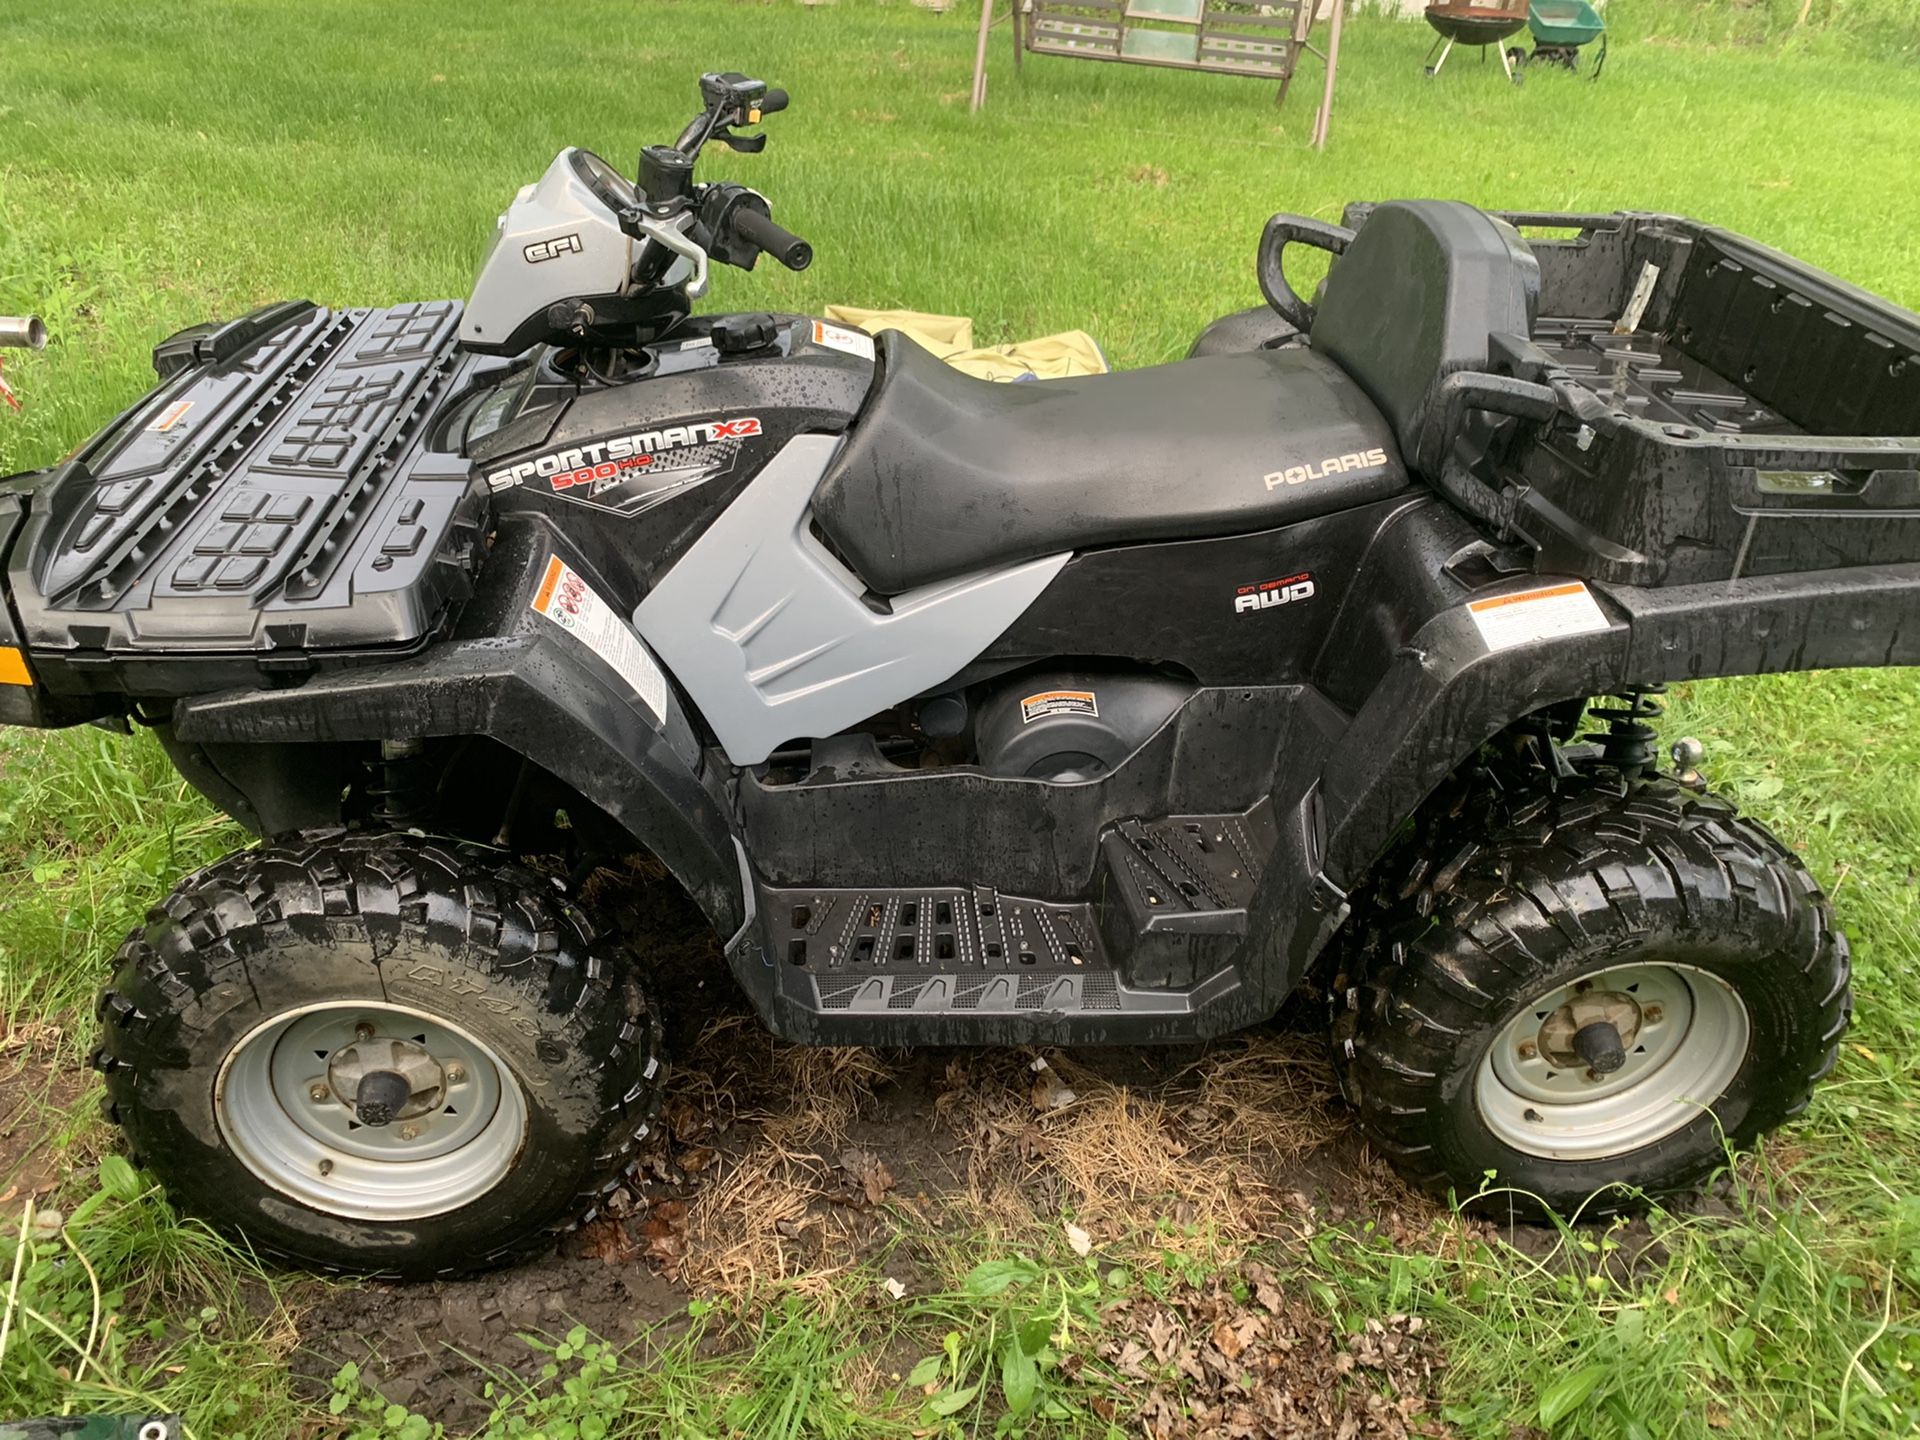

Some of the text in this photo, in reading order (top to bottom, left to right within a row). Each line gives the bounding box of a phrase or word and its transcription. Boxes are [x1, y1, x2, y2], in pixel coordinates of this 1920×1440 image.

[523, 233, 583, 264] EFI
[488, 417, 763, 493] SPORTSMAN X2
[1263, 448, 1388, 491] POLARIS
[550, 461, 619, 491] 500
[1234, 580, 1315, 613] AWD
[1237, 572, 1310, 595] ON DEMAND
